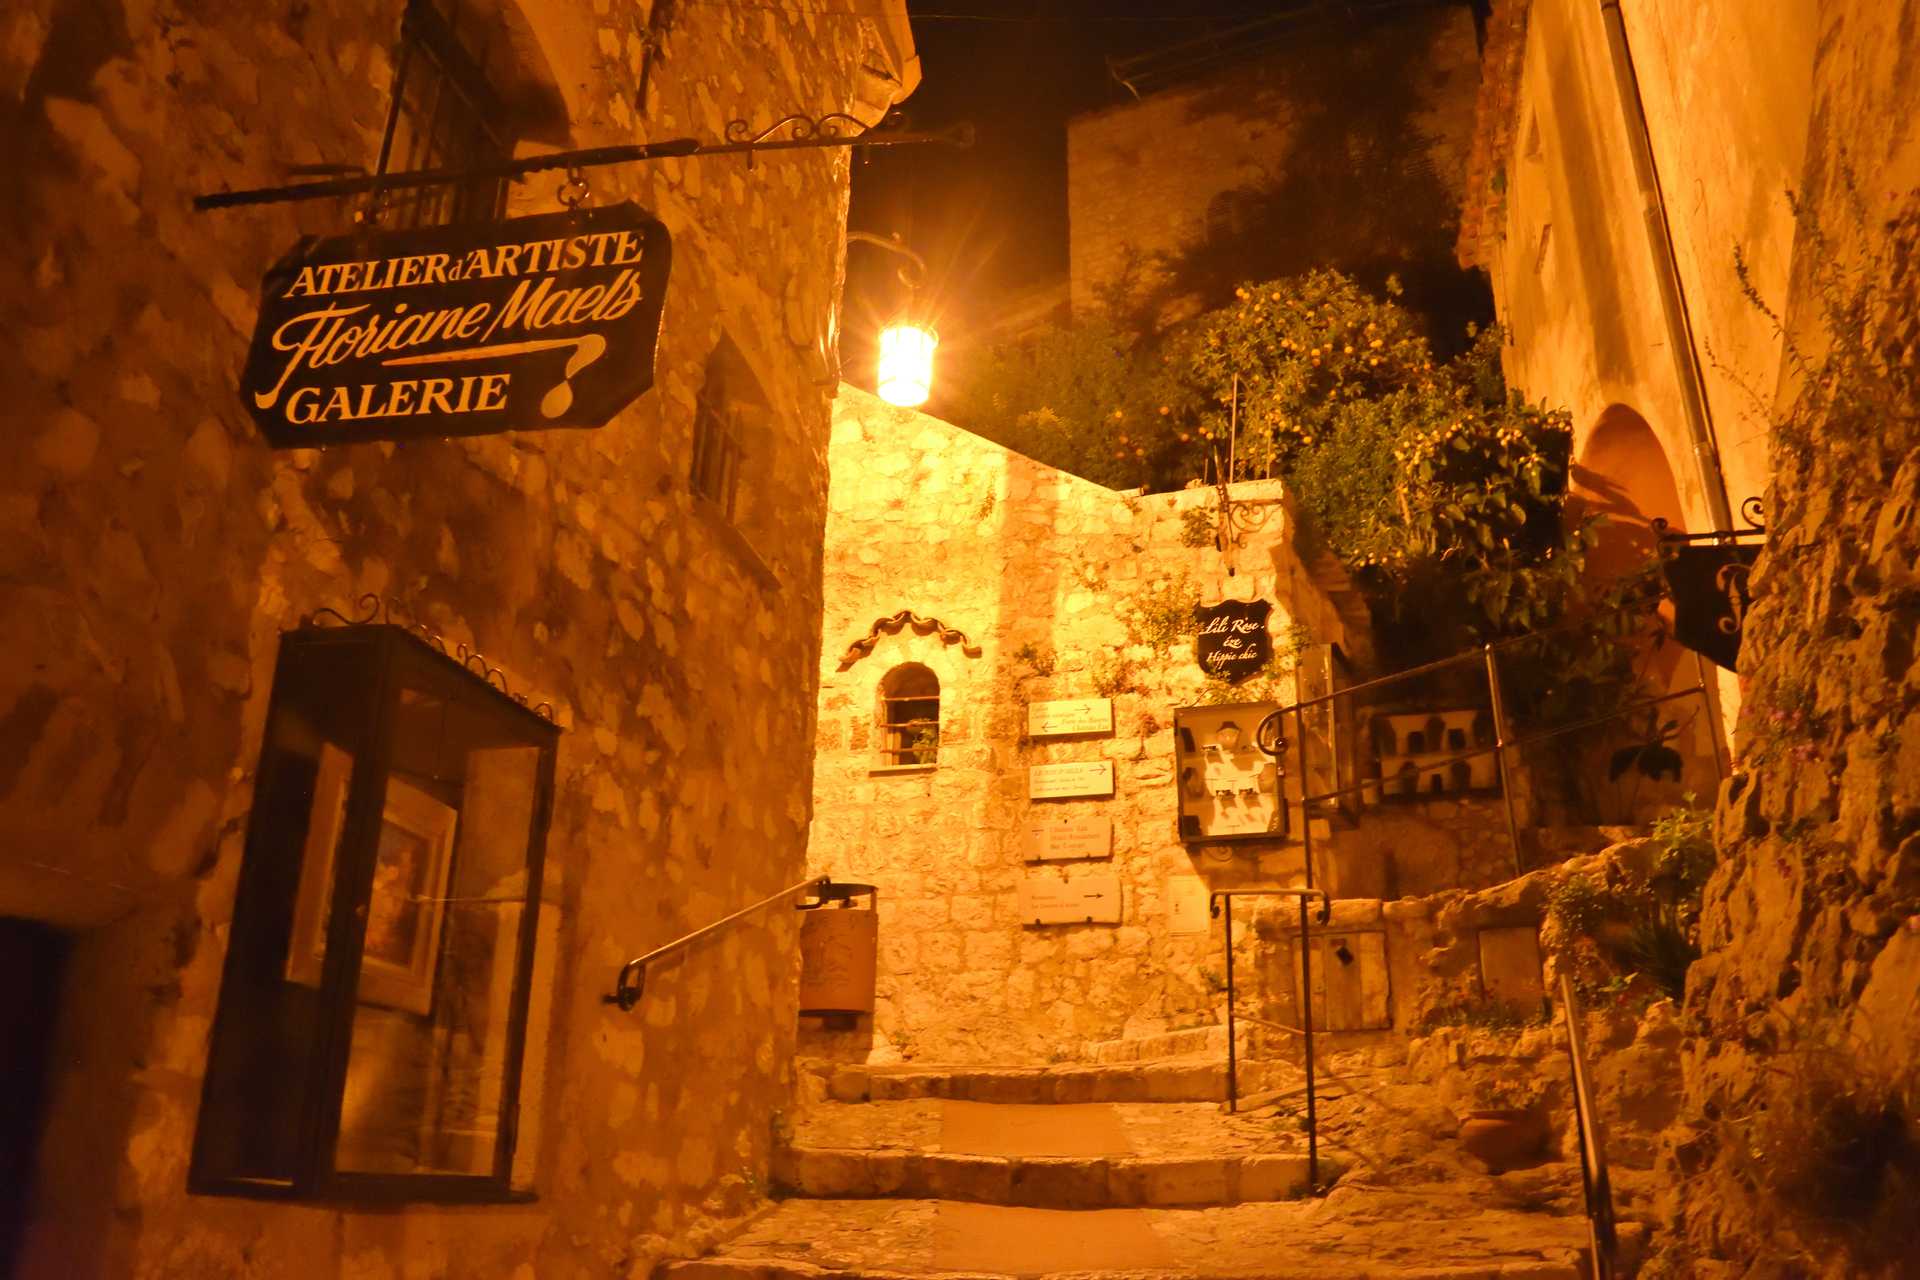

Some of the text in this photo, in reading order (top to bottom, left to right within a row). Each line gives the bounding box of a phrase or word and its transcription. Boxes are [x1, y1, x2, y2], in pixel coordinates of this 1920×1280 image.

[282, 254, 449, 298] ATELIER
[254, 269, 643, 409] Floriane Maels
[286, 374, 511, 424] GALERIE
